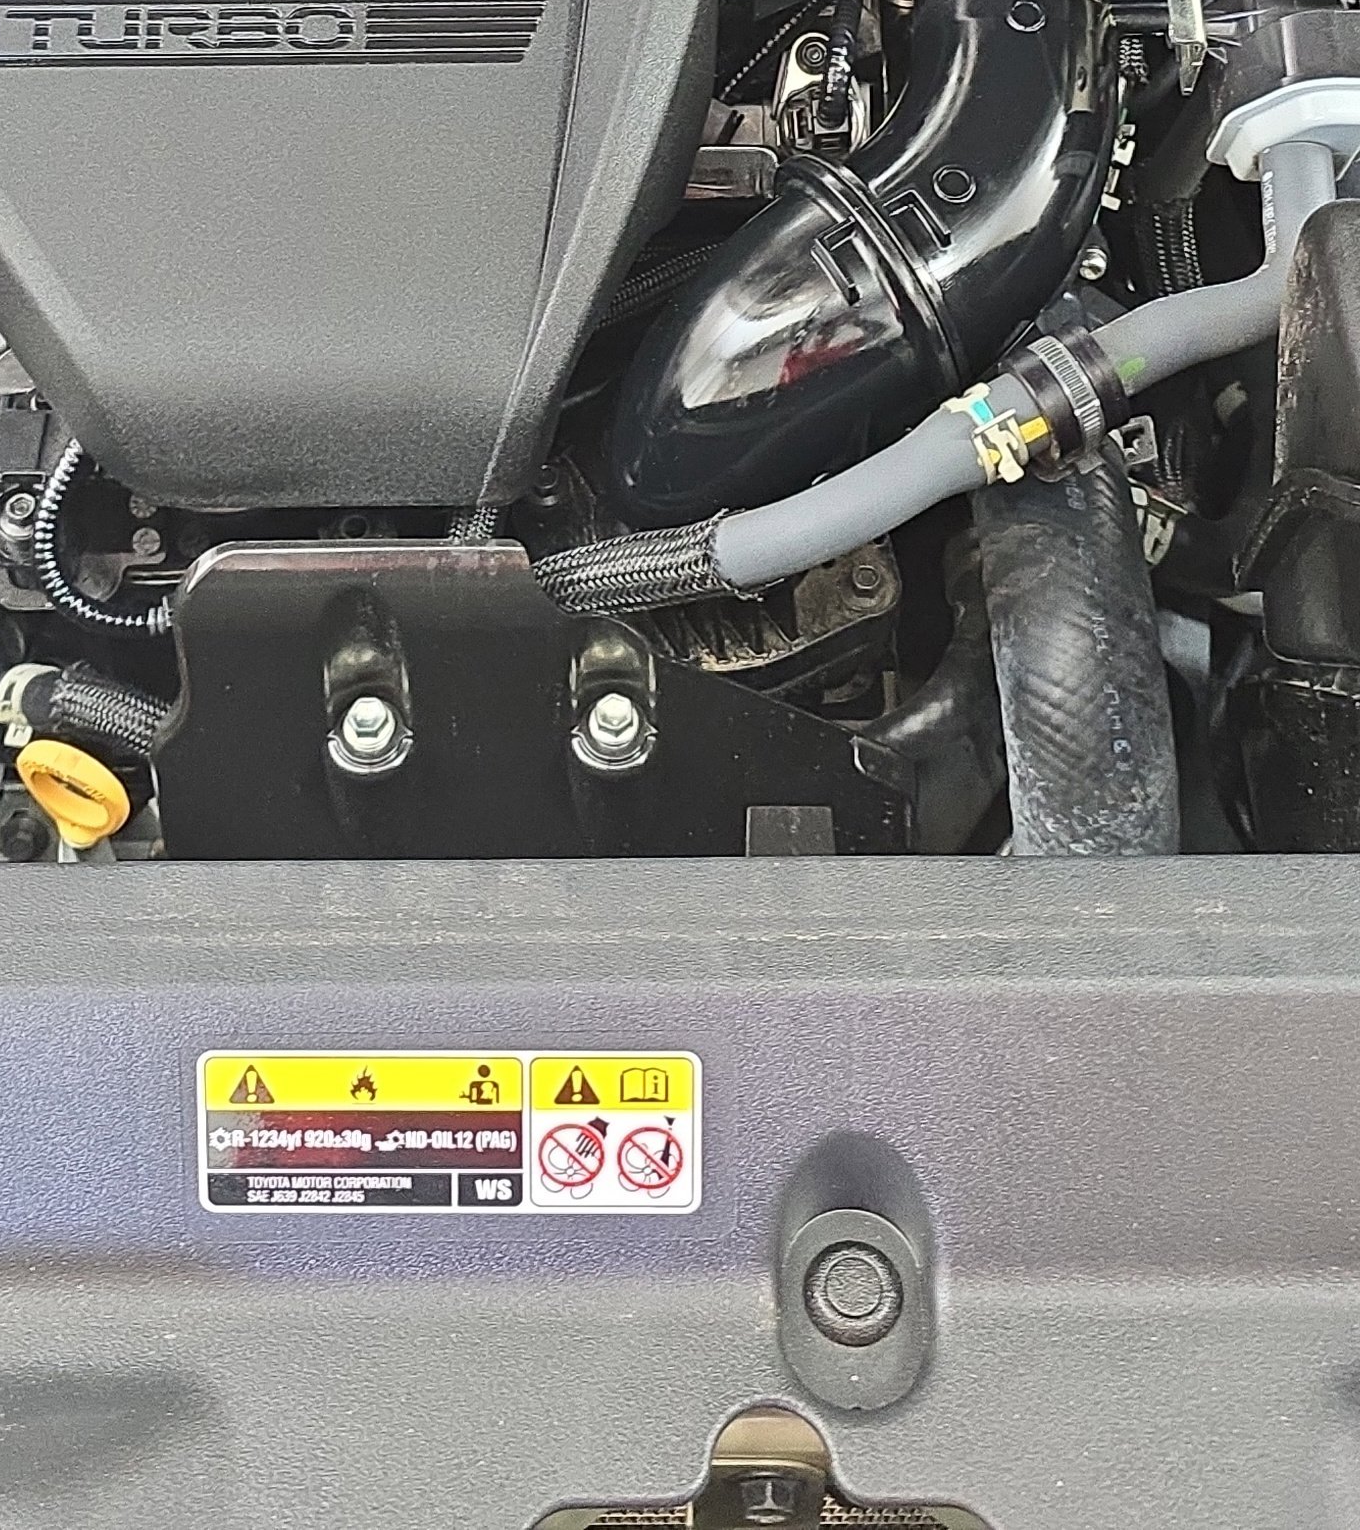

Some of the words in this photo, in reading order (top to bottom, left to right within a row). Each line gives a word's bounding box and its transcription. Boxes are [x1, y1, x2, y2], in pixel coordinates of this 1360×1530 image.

[5, 5, 359, 51] TURBO
[231, 1130, 302, 1152] R-1234yf
[475, 1130, 517, 1152] (PAG)
[247, 1176, 290, 1189] TOYOTA
[291, 1176, 332, 1189] MOTOR
[333, 1176, 412, 1189] CORPORATION
[475, 1179, 513, 1200] WS
[247, 1190, 270, 1203] SAE
[271, 1190, 297, 1203] J639
[298, 1190, 331, 1203] J2842
[331, 1190, 366, 1203] J2845
